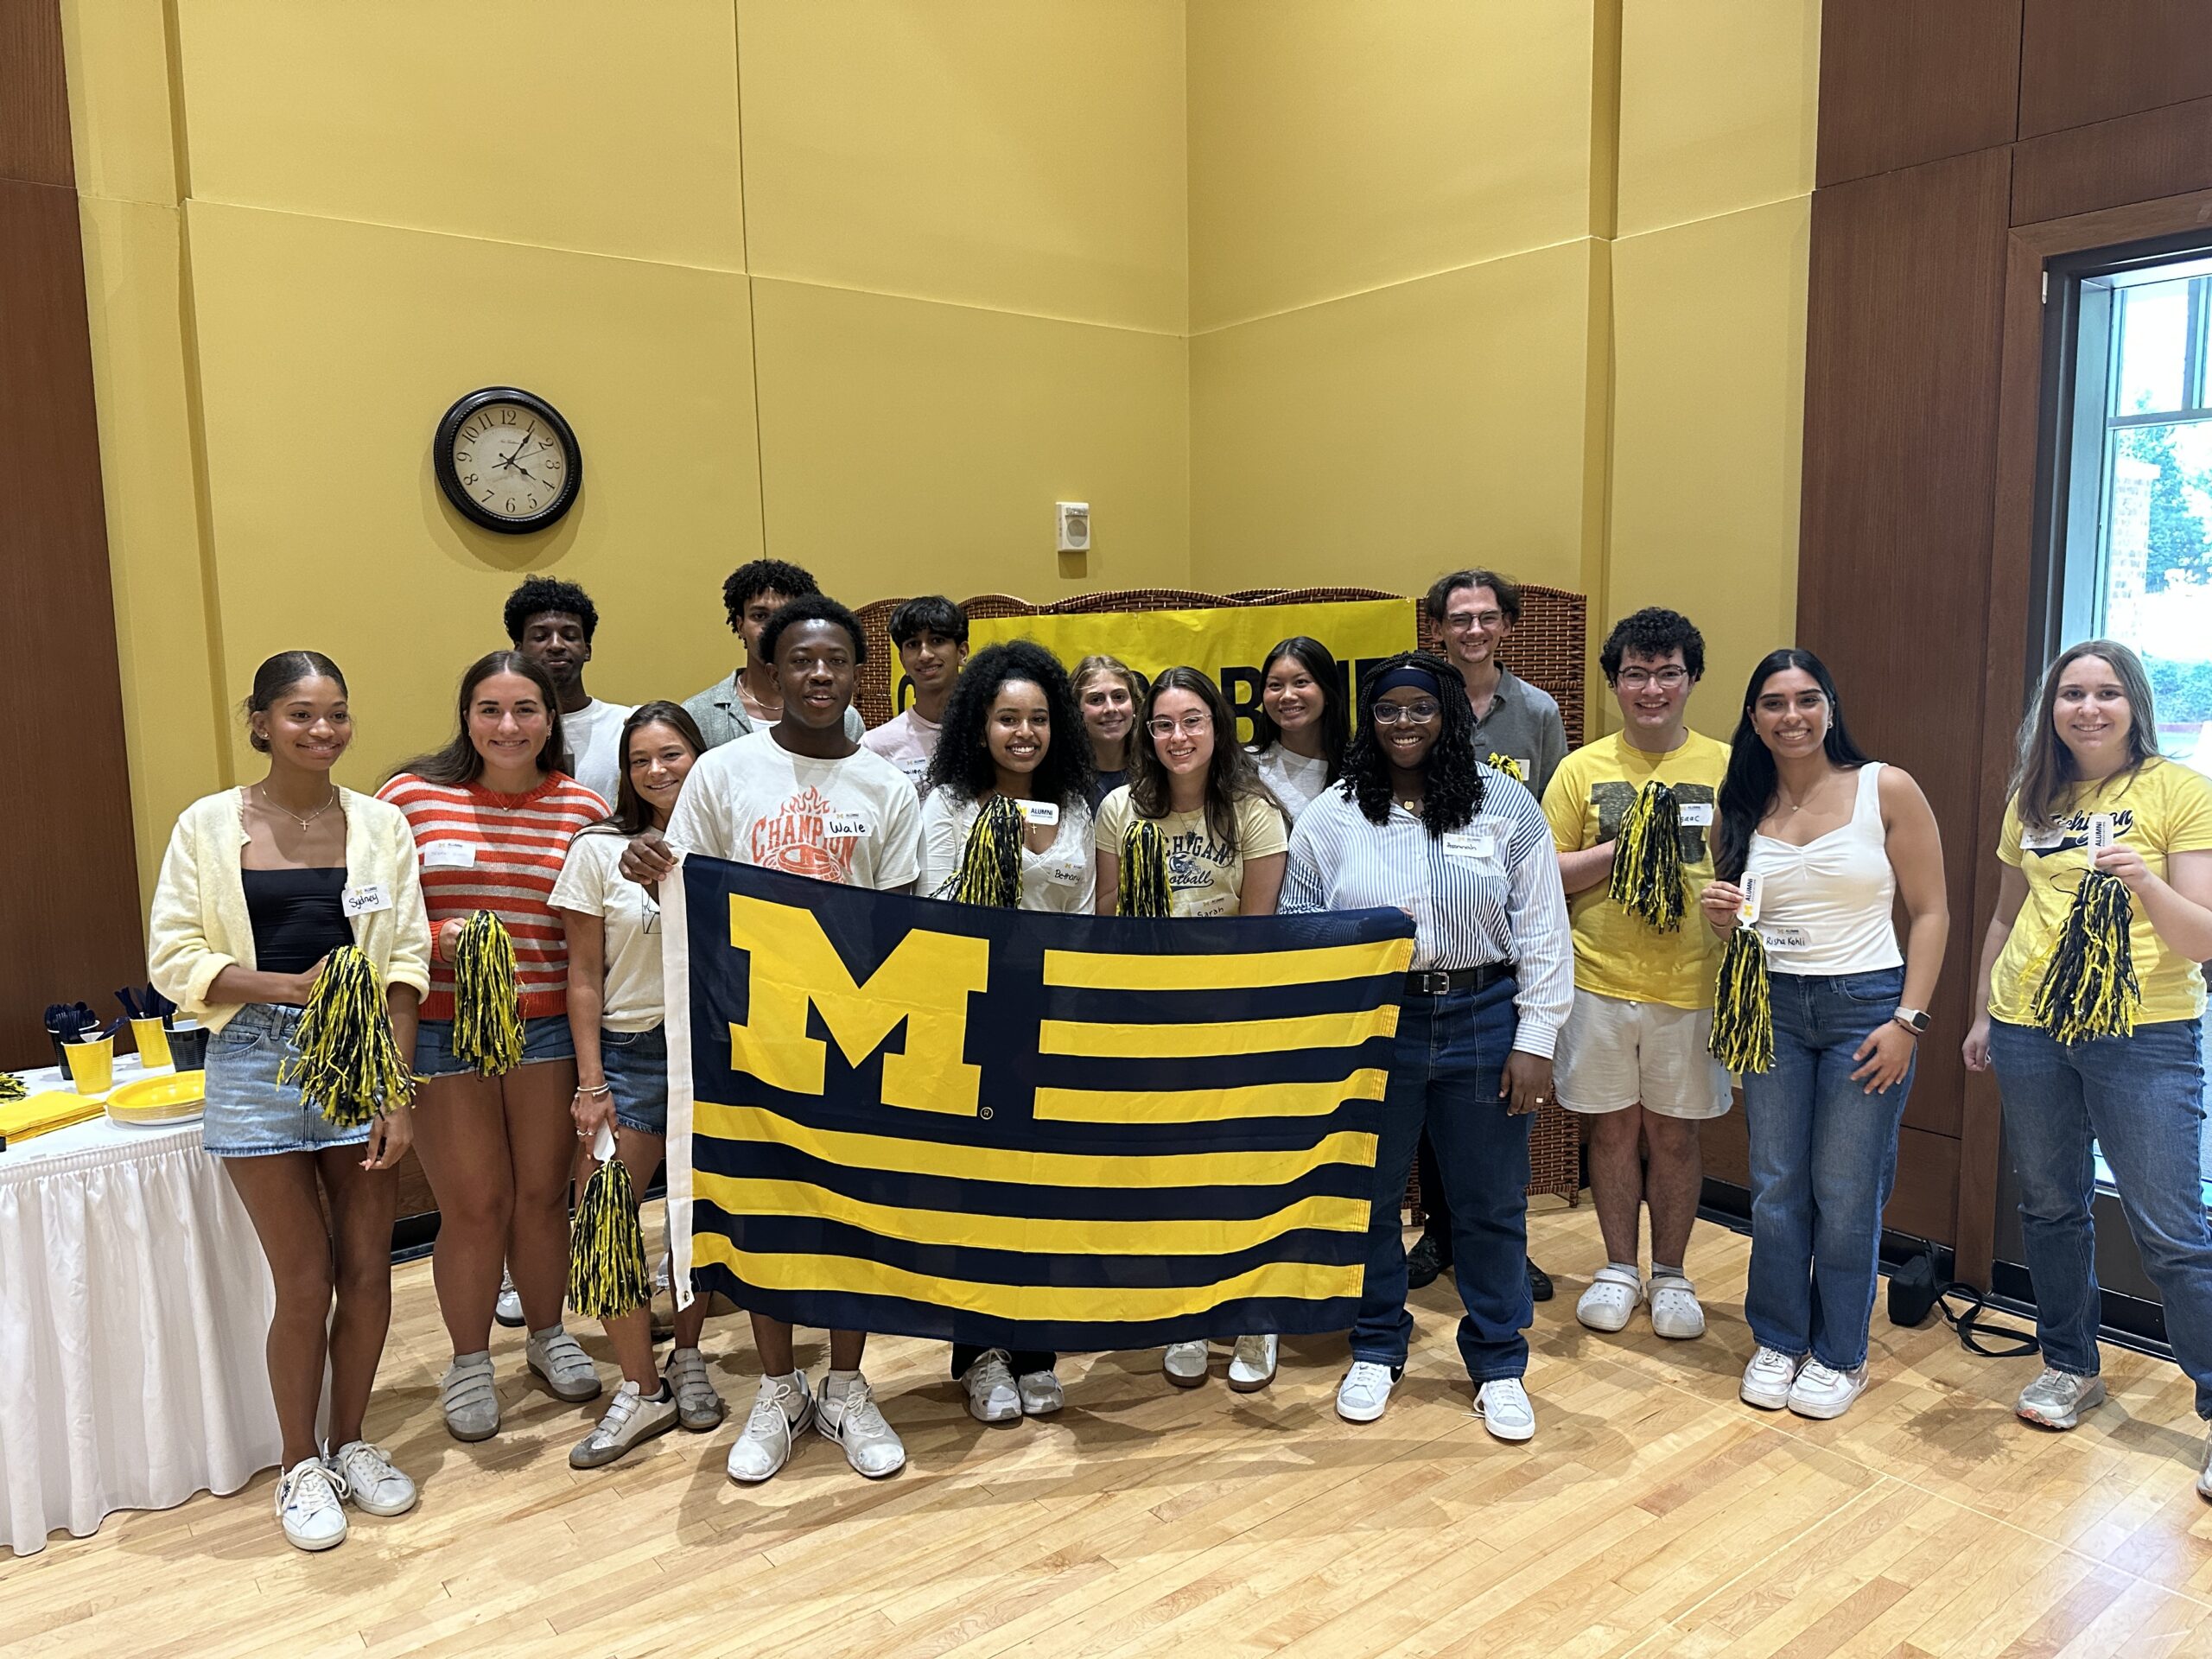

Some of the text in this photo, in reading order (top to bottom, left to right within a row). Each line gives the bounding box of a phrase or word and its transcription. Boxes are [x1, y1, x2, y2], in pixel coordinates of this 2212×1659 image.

[477, 413, 494, 430] 11
[500, 410, 517, 425] 12
[525, 420, 535, 433] 1
[461, 426, 480, 444] 10
[538, 437, 554, 450] 2
[456, 452, 472, 462] 9
[545, 460, 561, 470] 3
[463, 474, 479, 486] 8
[542, 480, 556, 492] 4
[481, 489, 495, 503] 7
[526, 493, 537, 509] 5
[505, 498, 516, 512] 6
[830, 821, 865, 833] Wale
[1169, 870, 1213, 886] otball
[349, 893, 379, 909] Sydney
[1198, 906, 1224, 917] Sarah
[728, 893, 989, 1116] M
